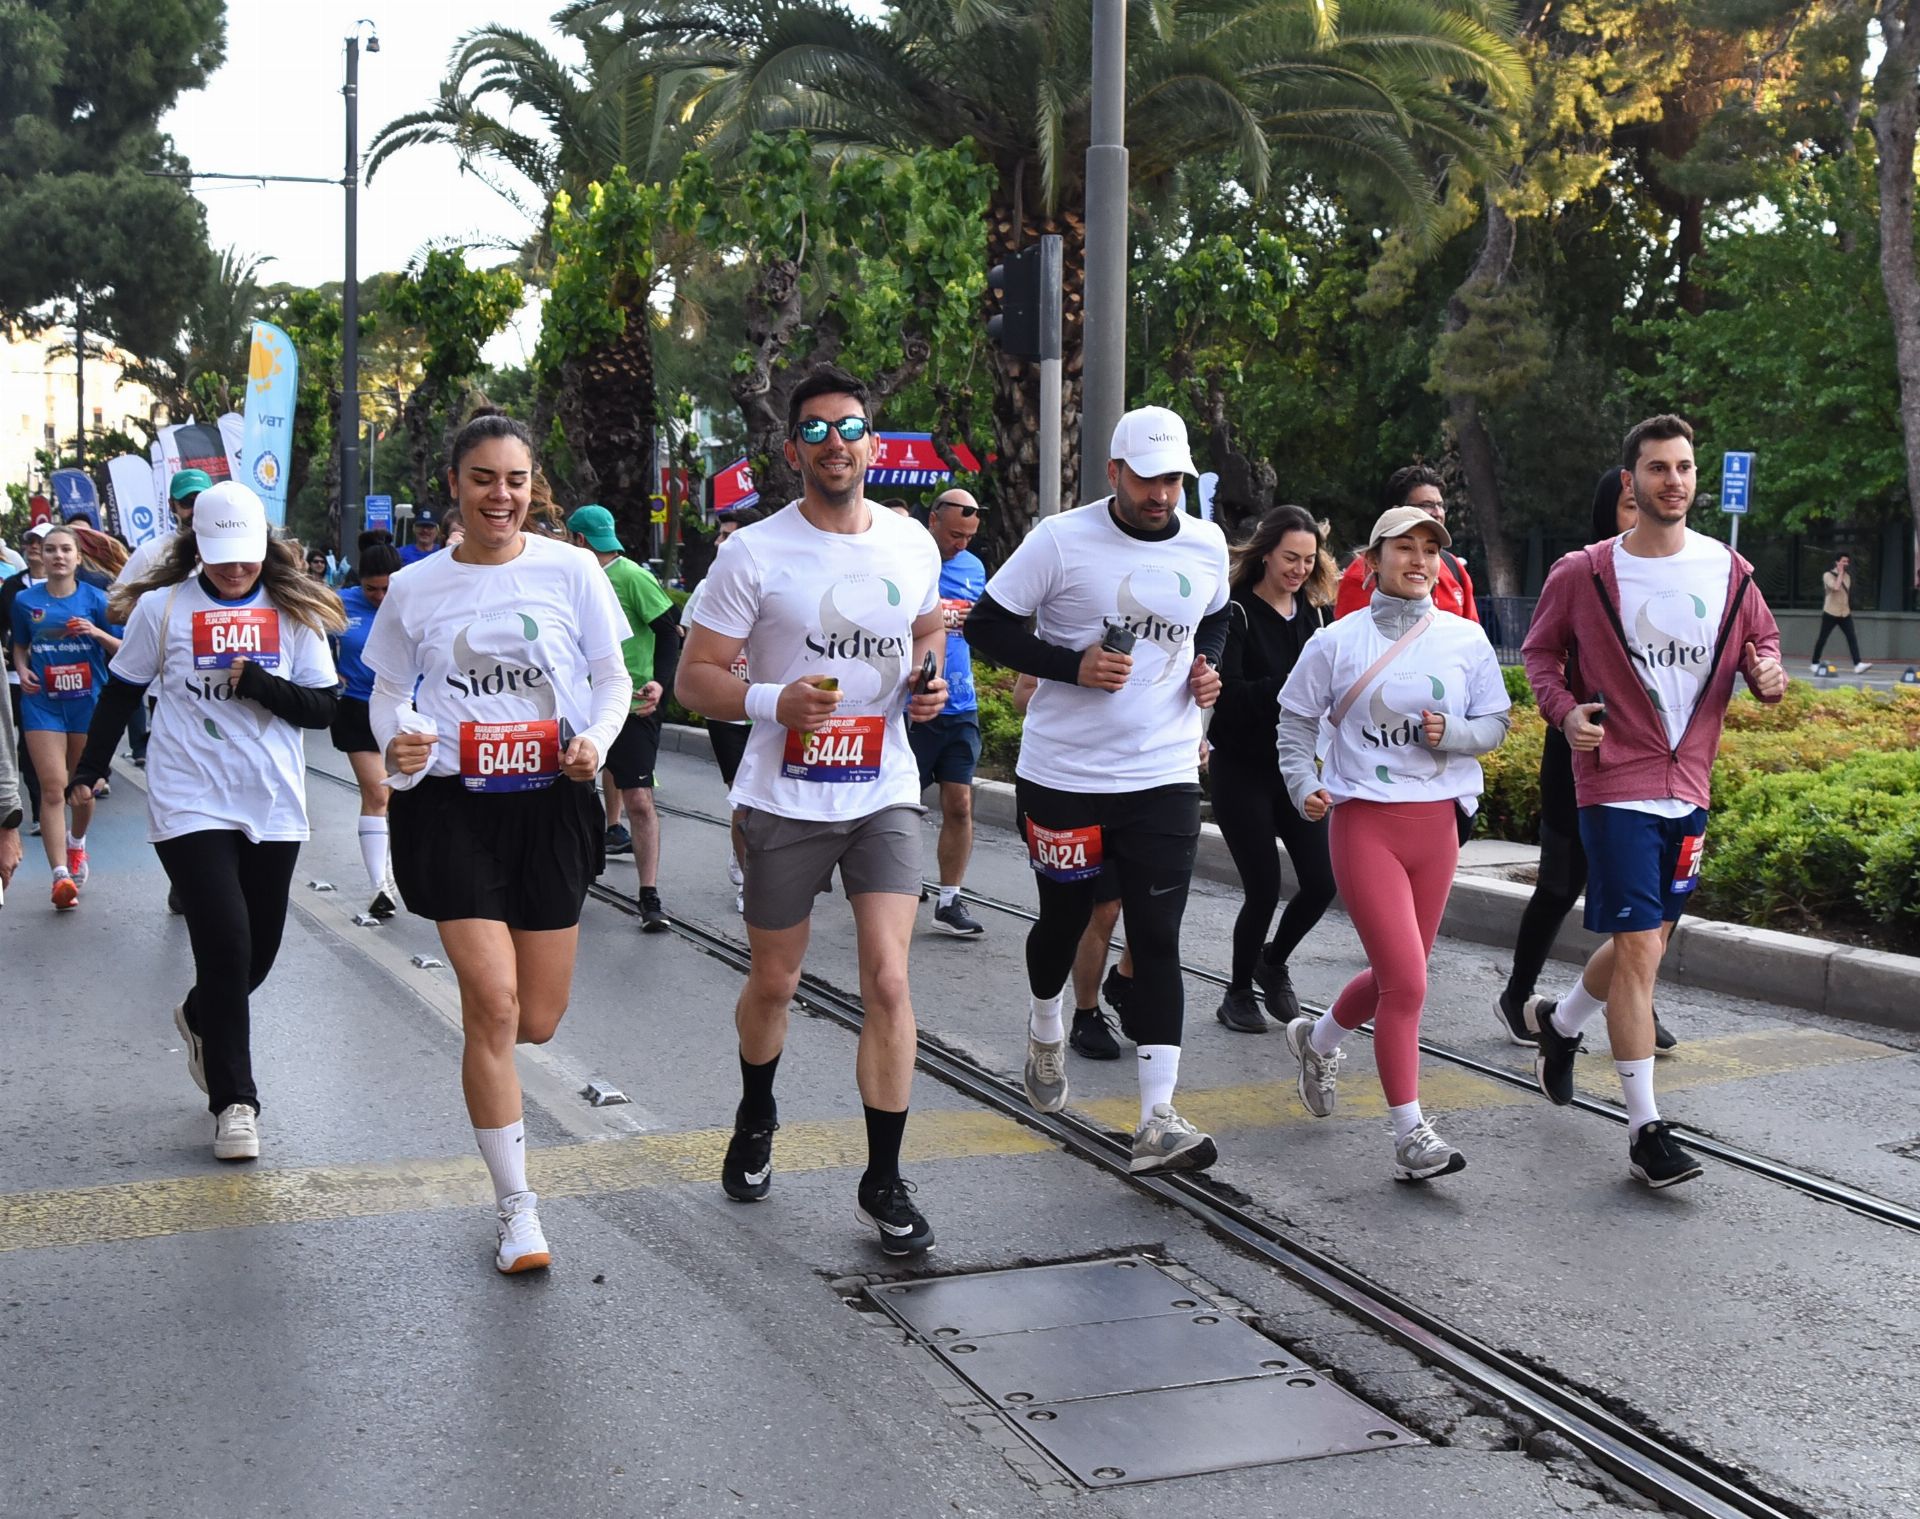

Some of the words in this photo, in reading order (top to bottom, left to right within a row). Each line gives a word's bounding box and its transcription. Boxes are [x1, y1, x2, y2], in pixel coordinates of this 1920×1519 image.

[890, 470, 950, 484] FINISH
[211, 624, 261, 653] 6441
[54, 673, 83, 691] 4013
[185, 676, 233, 701] Sid
[445, 664, 554, 699] Sidre
[1361, 719, 1423, 749] Sidr
[478, 740, 541, 775] 6443
[803, 734, 864, 766] 6444
[1037, 839, 1087, 870] 6424
